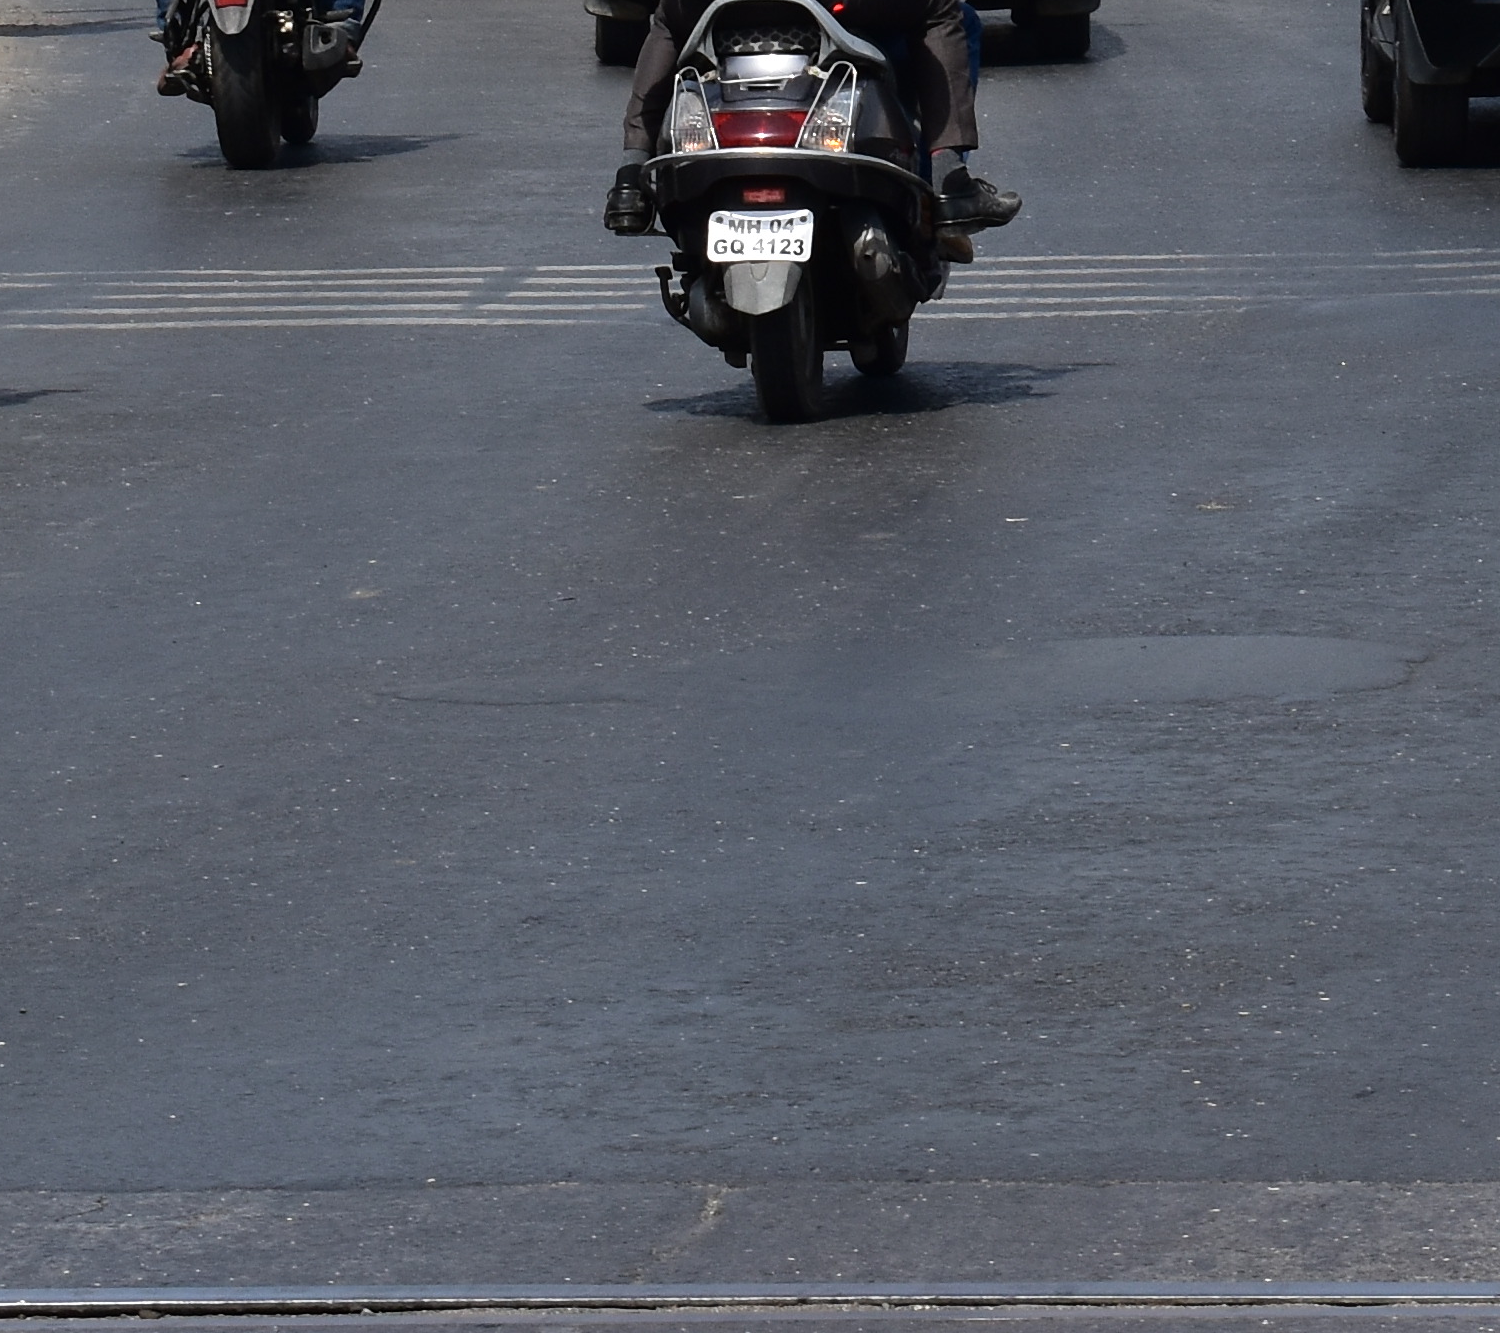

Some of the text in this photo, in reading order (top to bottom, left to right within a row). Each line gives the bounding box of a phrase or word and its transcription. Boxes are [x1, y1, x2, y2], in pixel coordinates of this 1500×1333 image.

[728, 218, 794, 234] MH 04
[713, 238, 804, 256] GQ 4123
